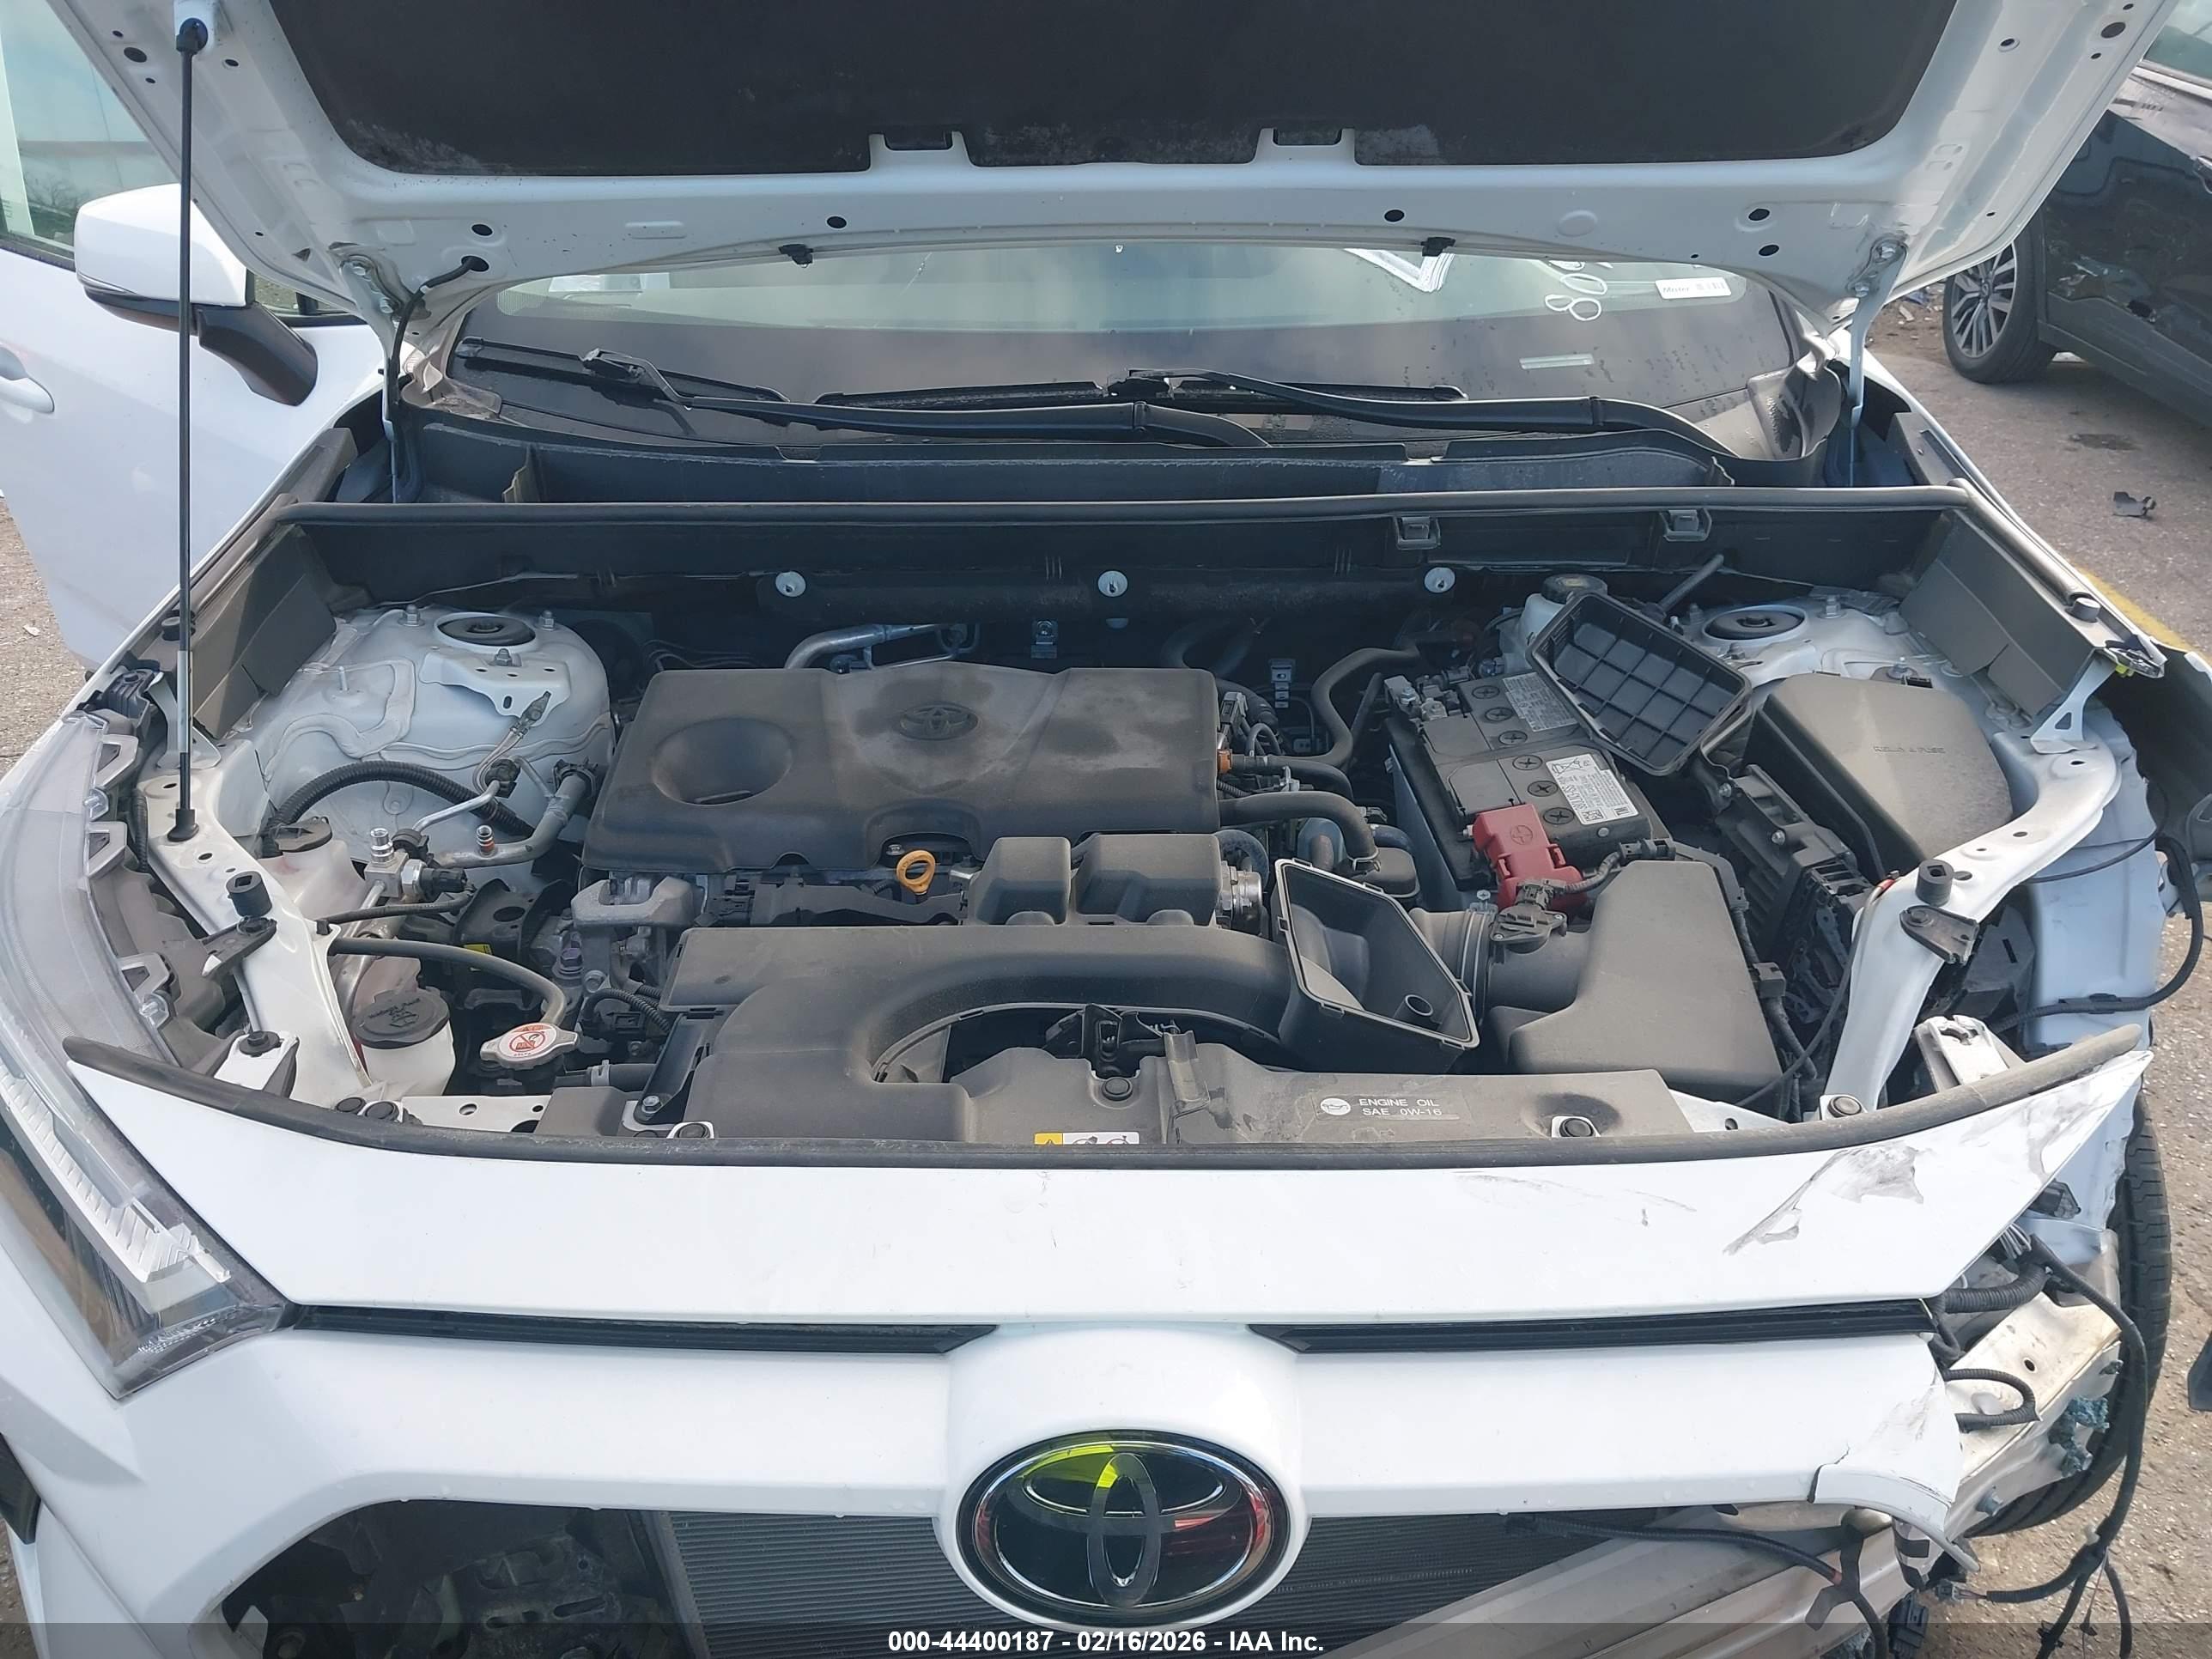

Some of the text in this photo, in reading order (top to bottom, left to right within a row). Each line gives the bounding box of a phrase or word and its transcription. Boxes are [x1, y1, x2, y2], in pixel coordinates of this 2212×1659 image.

[1358, 1098, 1408, 1107] ENGINE
[1362, 1108, 1443, 1116] SAE 0W-16
